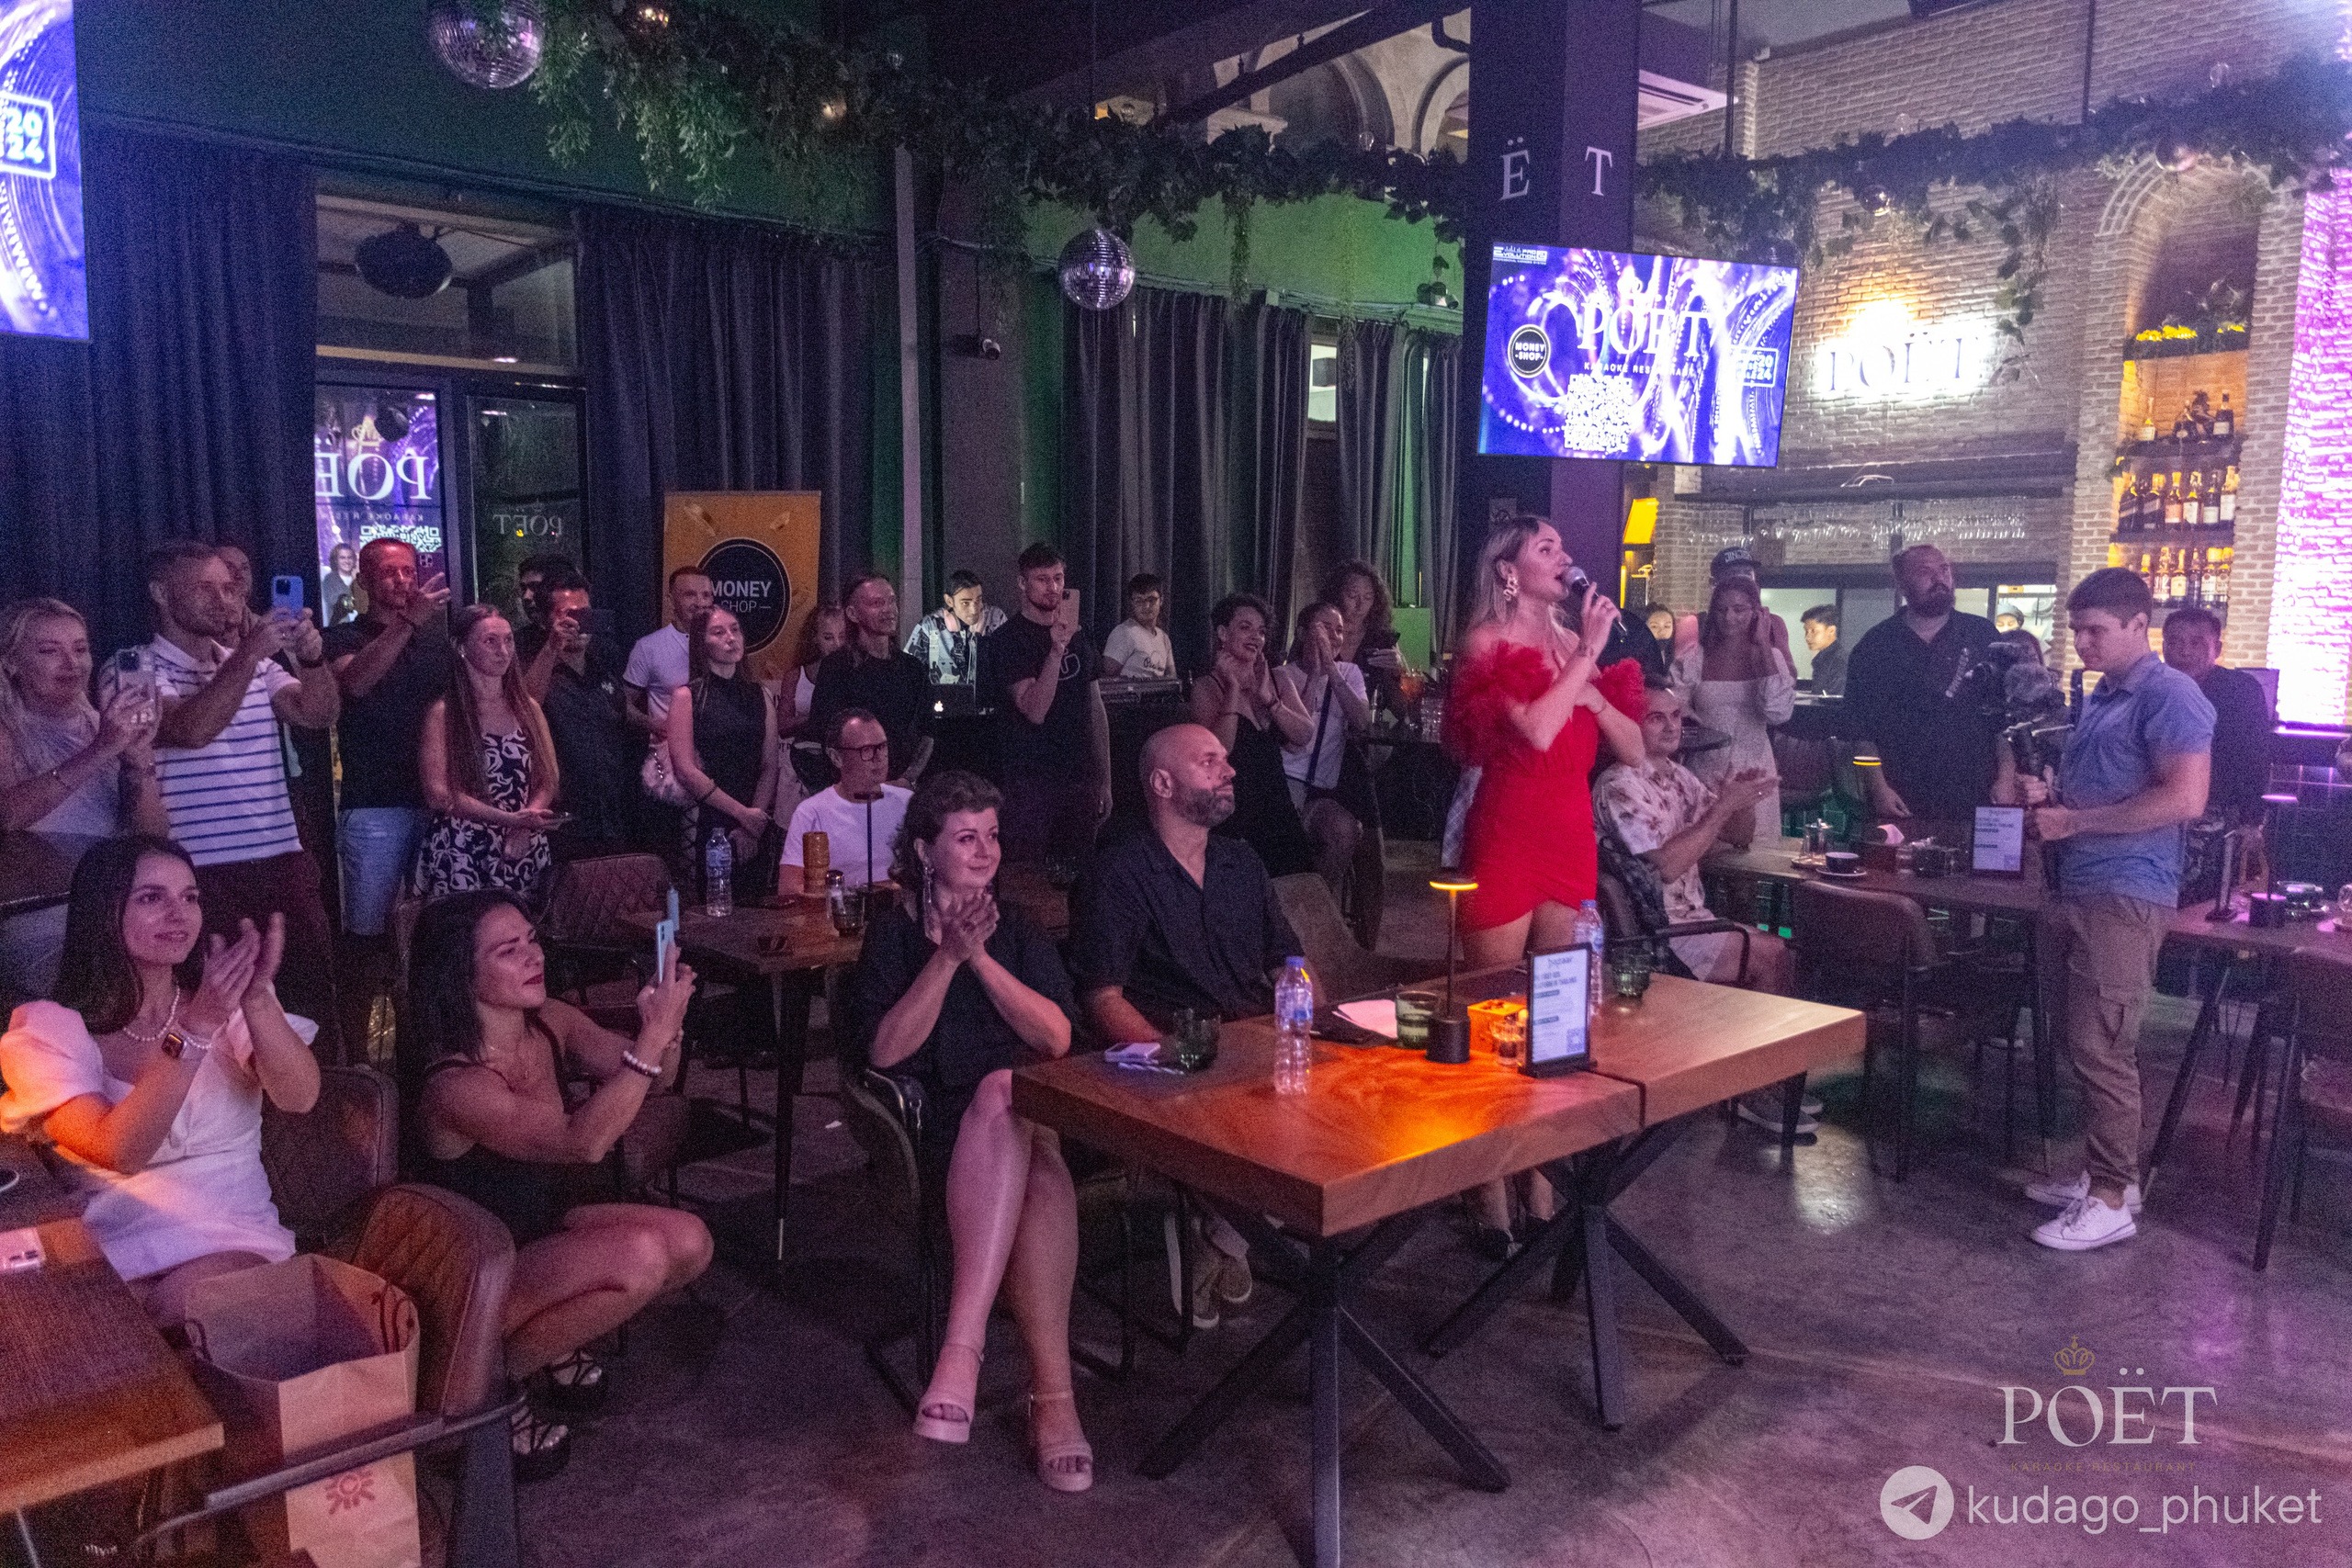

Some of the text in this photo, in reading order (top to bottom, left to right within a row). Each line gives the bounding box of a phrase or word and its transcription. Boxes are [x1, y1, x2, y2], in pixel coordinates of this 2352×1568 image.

[6, 107, 42, 138] 20
[6, 133, 44, 164] 24
[1515, 342, 1545, 353] MONEY
[711, 581, 772, 597] MONEY
